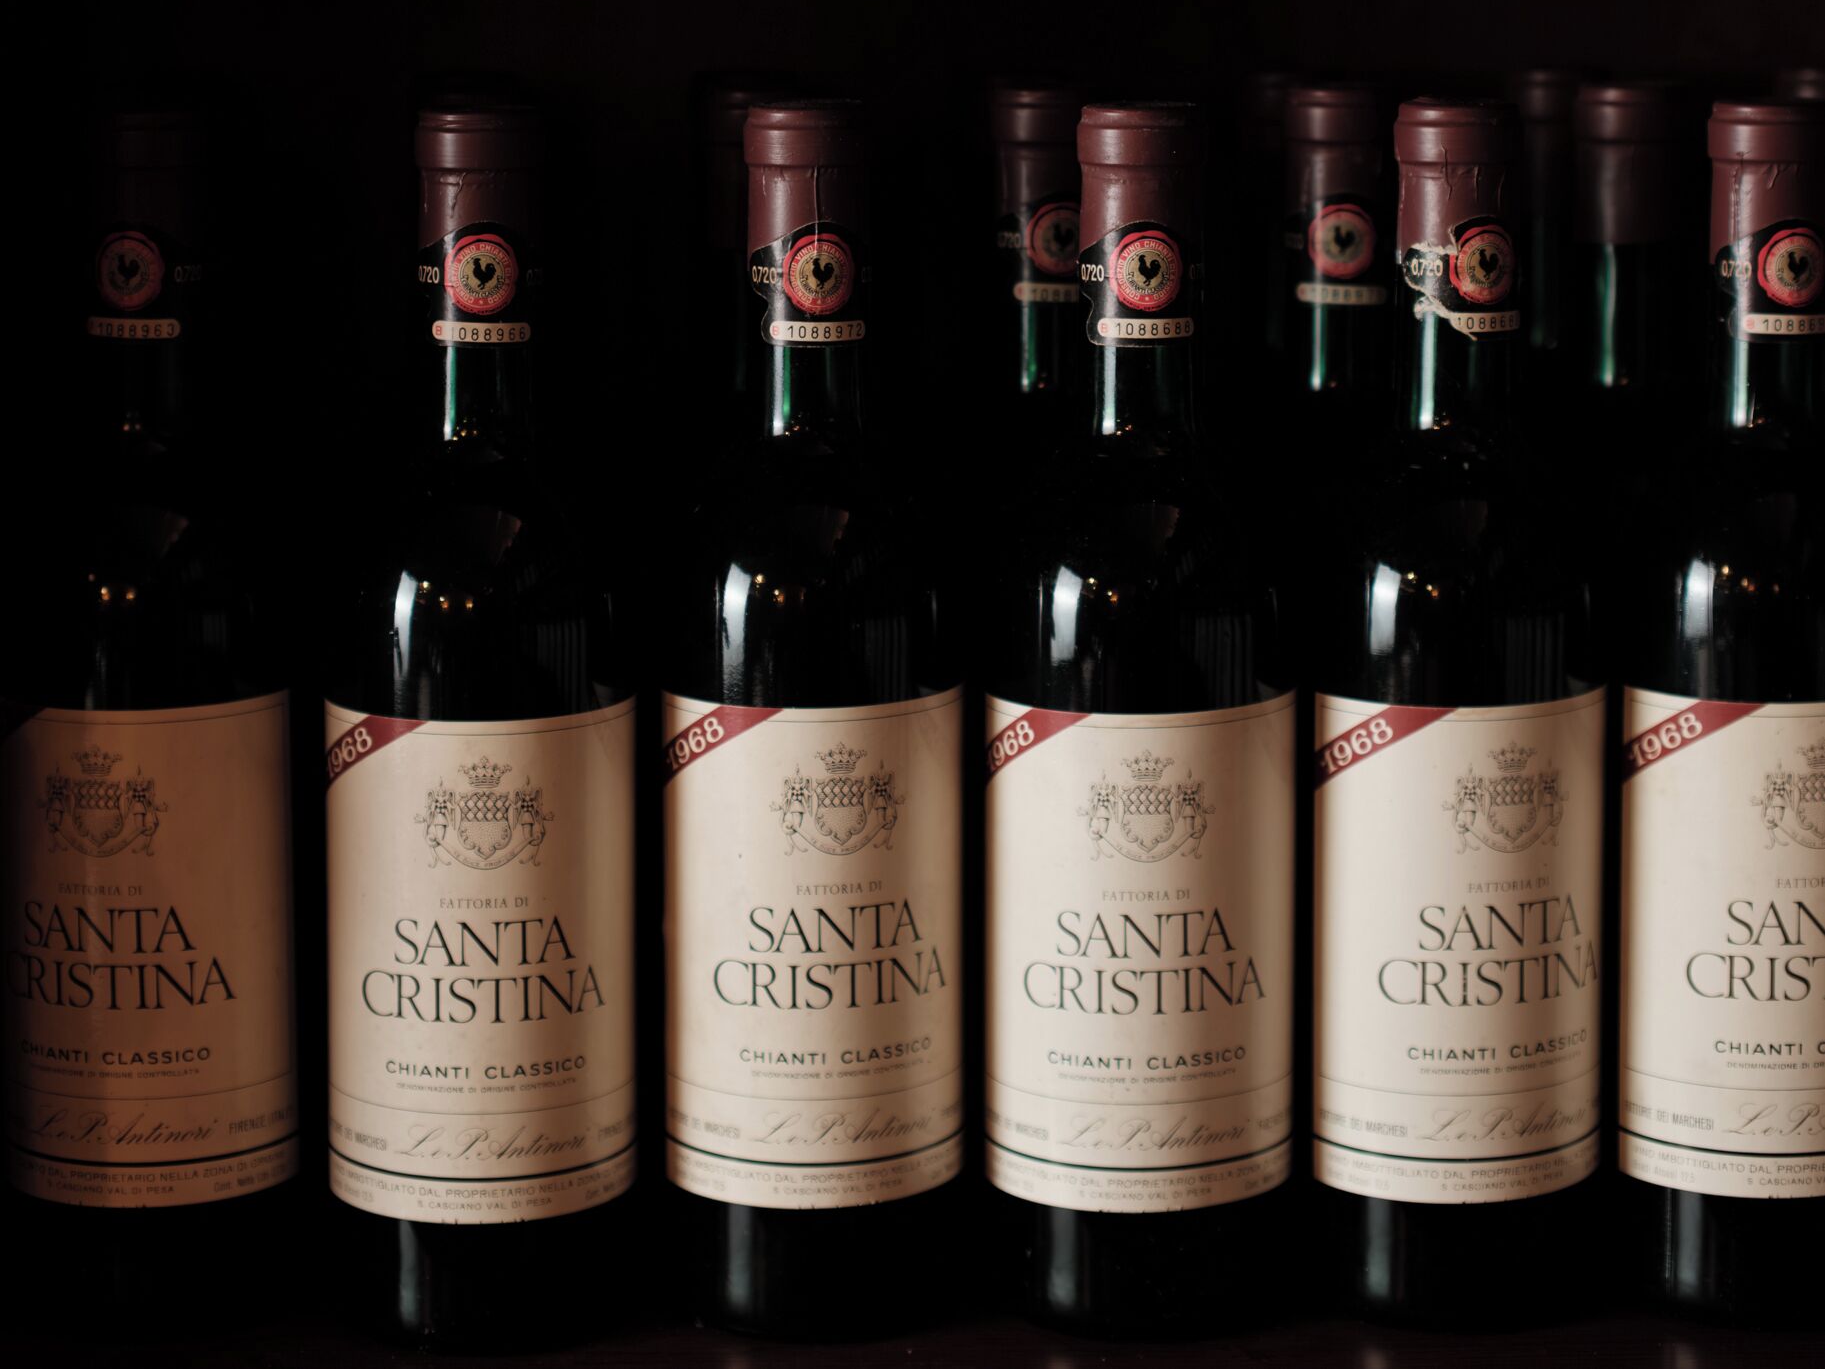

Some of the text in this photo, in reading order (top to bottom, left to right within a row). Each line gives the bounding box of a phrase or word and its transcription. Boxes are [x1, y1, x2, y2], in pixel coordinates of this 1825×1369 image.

[1411, 258, 1444, 277] 0,720
[788, 323, 863, 340] 1088972
[1116, 321, 1191, 337] 1088688
[668, 716, 726, 772] 1968
[1323, 717, 1394, 776] 1968
[1632, 712, 1703, 770] 1968
[57, 883, 144, 897] FATTORIA DI
[796, 880, 883, 896] FATTORIA DI
[1101, 888, 1190, 903] FATTORIA DI
[1466, 879, 1532, 894] FATTORIA
[439, 896, 529, 910] FATTORIA DI
[24, 901, 198, 954] SANTA
[749, 895, 924, 954] SANTA
[1055, 906, 1238, 960] SANTA
[1417, 893, 1584, 952] SANTA
[393, 914, 577, 968] SANTA
[8, 950, 238, 1011] CRISTINA
[712, 943, 947, 1010] CRISTINA
[1377, 939, 1598, 1007] CRISTINA
[361, 963, 606, 1024] CRISTINA
[1022, 955, 1266, 1016] CRISTINA
[102, 1046, 213, 1066] CLASSICO
[739, 1035, 932, 1066] CHIANTI CLASSICO
[1406, 1028, 1588, 1063] CHIANTI CLASSICO
[1713, 1040, 1804, 1057] CHIANTI
[385, 1055, 587, 1080] CHIANTI CLASSICO
[1046, 1044, 1247, 1071] CHIANTI CLASSICO
[1365, 1119, 1408, 1139] MARCHESI
[1672, 1112, 1715, 1131] MARCHESI
[70, 1163, 233, 1183] PROPRIETARIO NELLA ZONA
[1749, 1164, 1773, 1175] DAL
[146, 1184, 175, 1196] PESA
[445, 1186, 536, 1201] PROPRIETARIO
[539, 1180, 575, 1195] NELLA
[1106, 1175, 1196, 1190] PROPRIETARIO
[486, 1197, 553, 1211] VAL PESA
